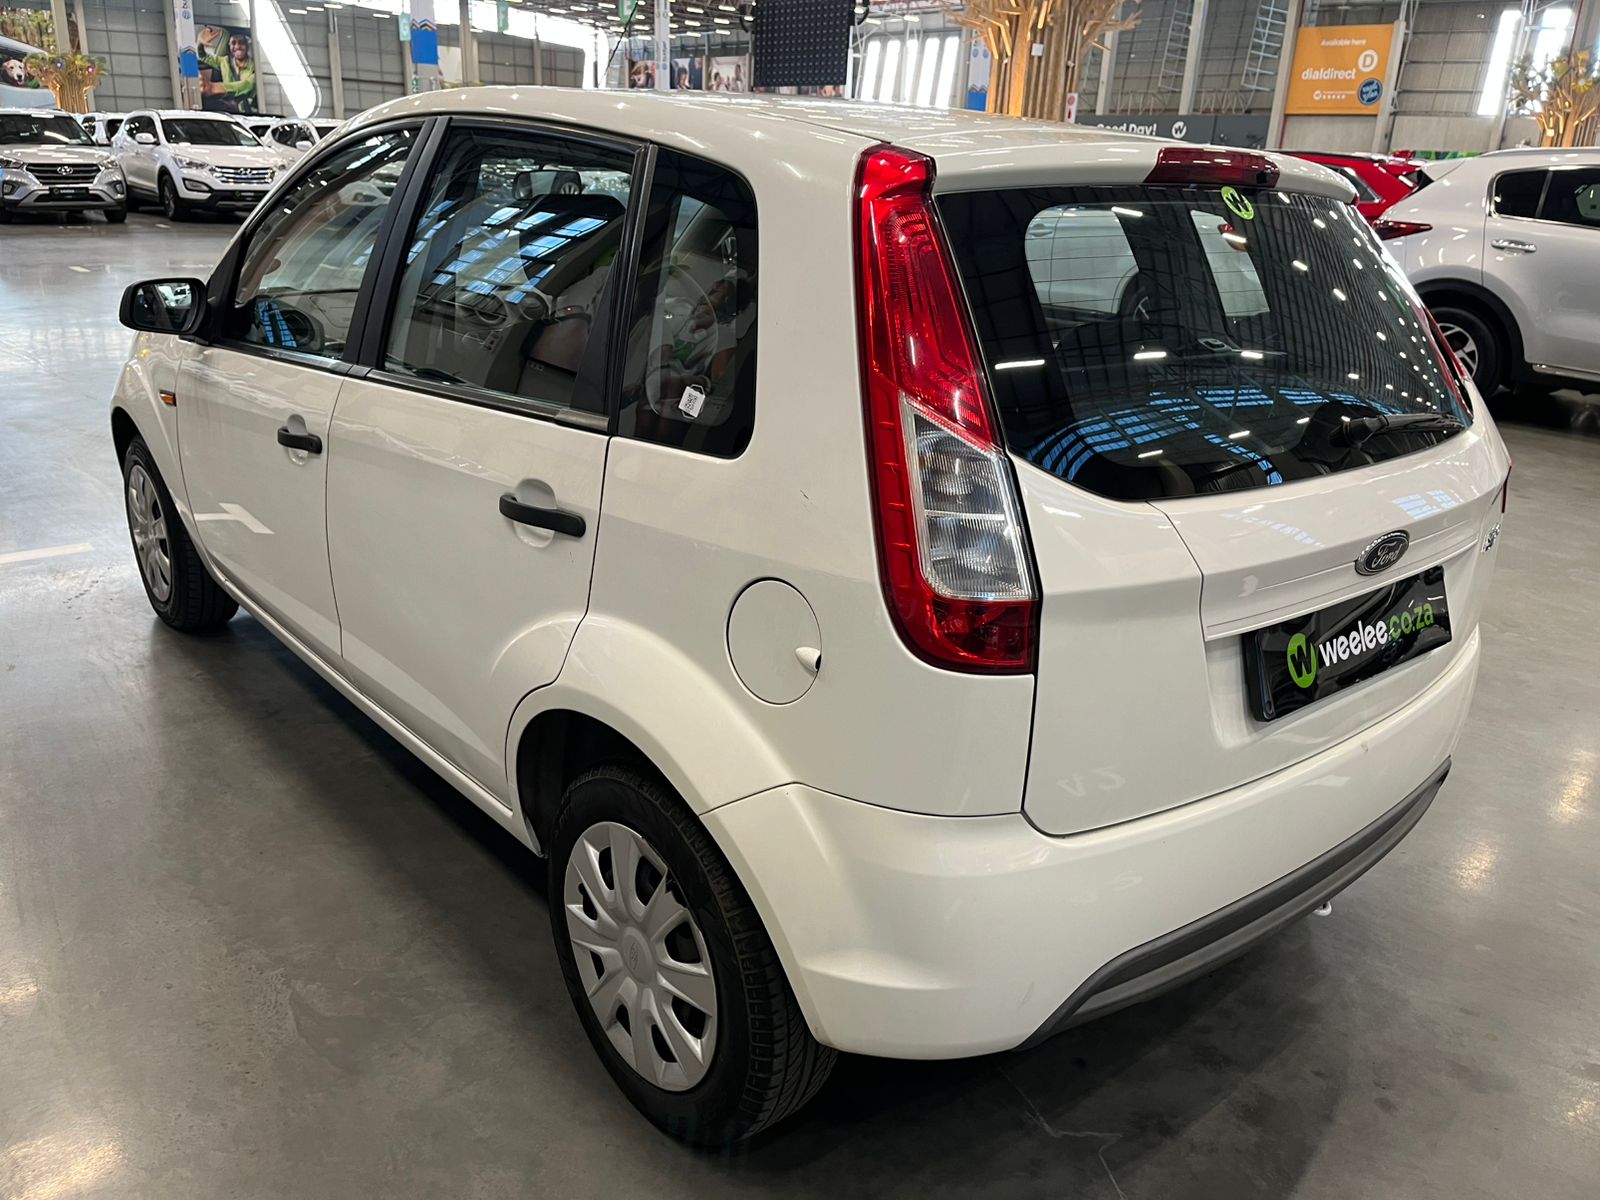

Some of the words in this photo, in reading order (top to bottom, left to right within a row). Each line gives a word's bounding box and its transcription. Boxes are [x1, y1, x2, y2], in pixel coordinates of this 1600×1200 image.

[1302, 67, 1356, 80] dialdirect
[1371, 541, 1404, 568] Ford
[1319, 602, 1434, 667] weelee.co.za
